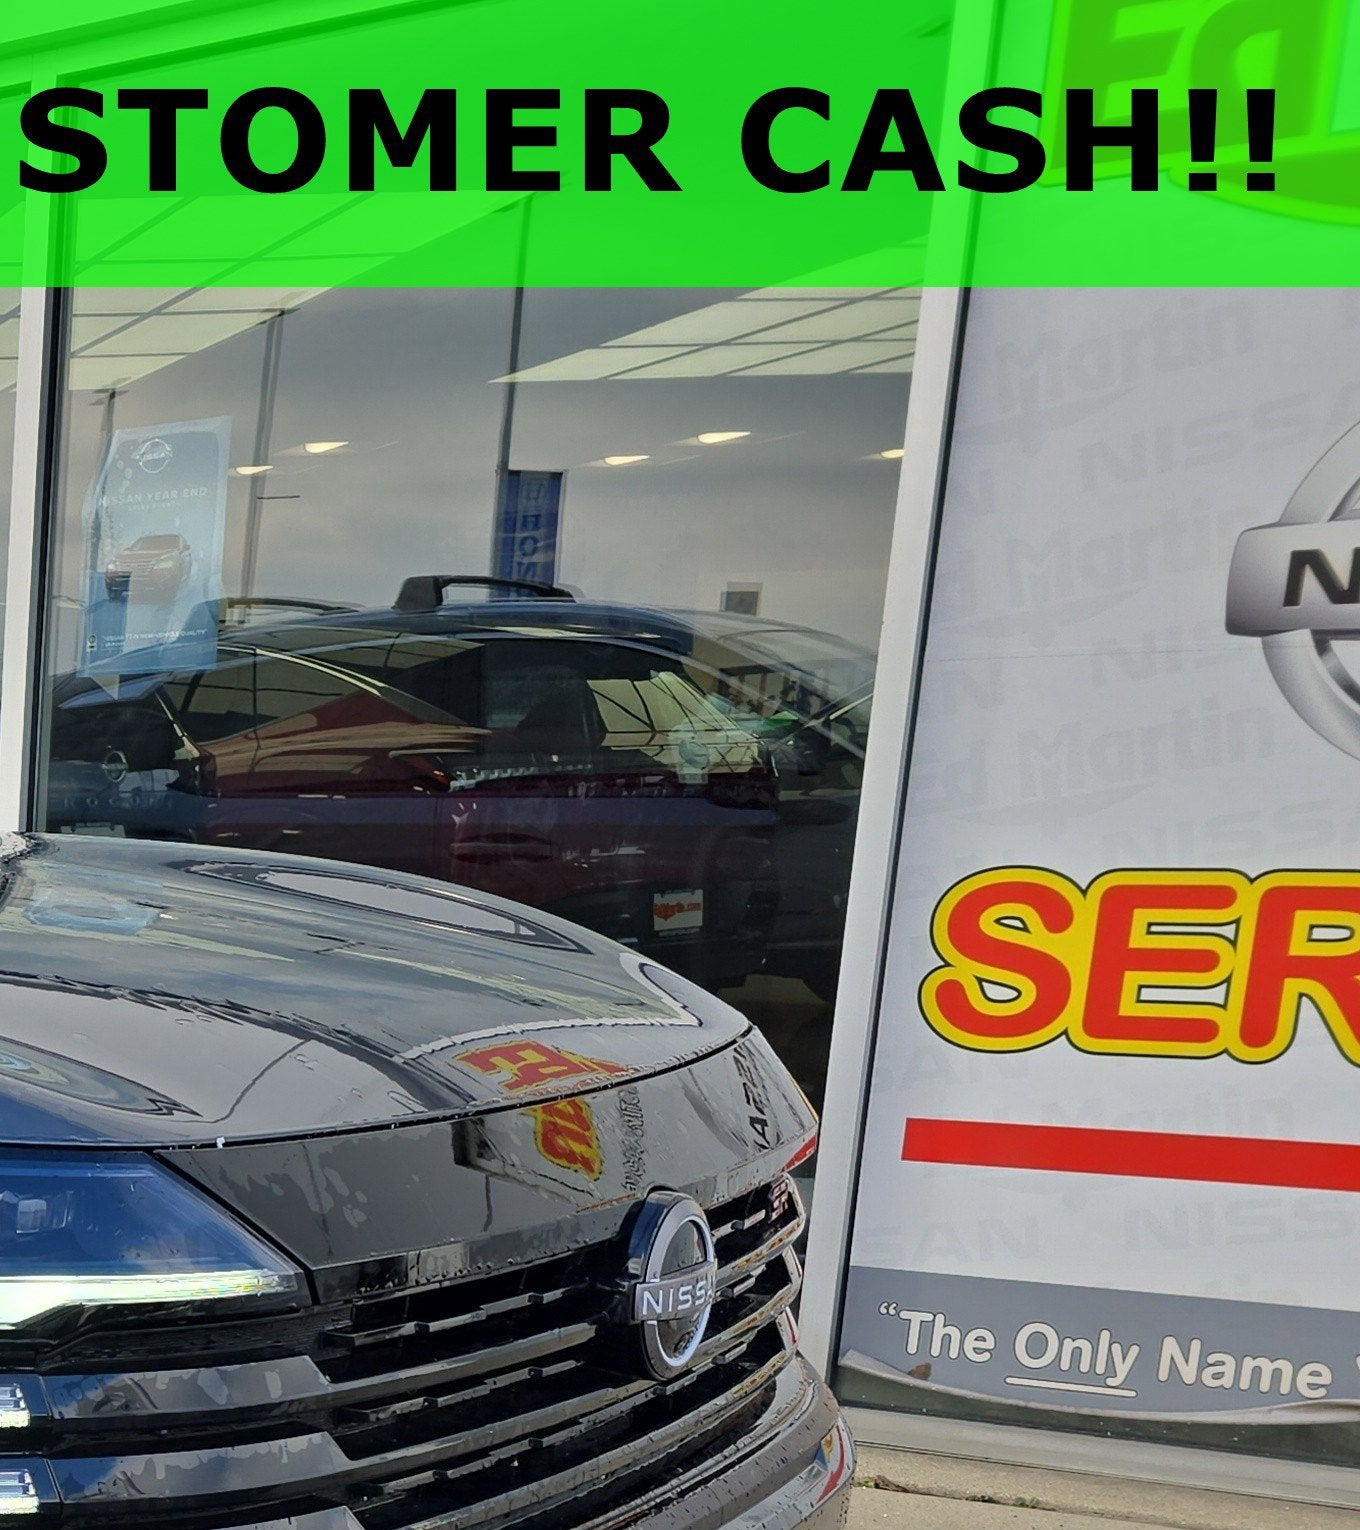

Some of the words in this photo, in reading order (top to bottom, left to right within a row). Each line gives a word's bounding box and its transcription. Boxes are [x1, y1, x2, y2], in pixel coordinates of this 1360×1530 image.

[182, 487, 208, 499] END
[919, 866, 1360, 1066] SER
[1013, 1320, 1141, 1389] Only
[1156, 1335, 1334, 1400] Name
